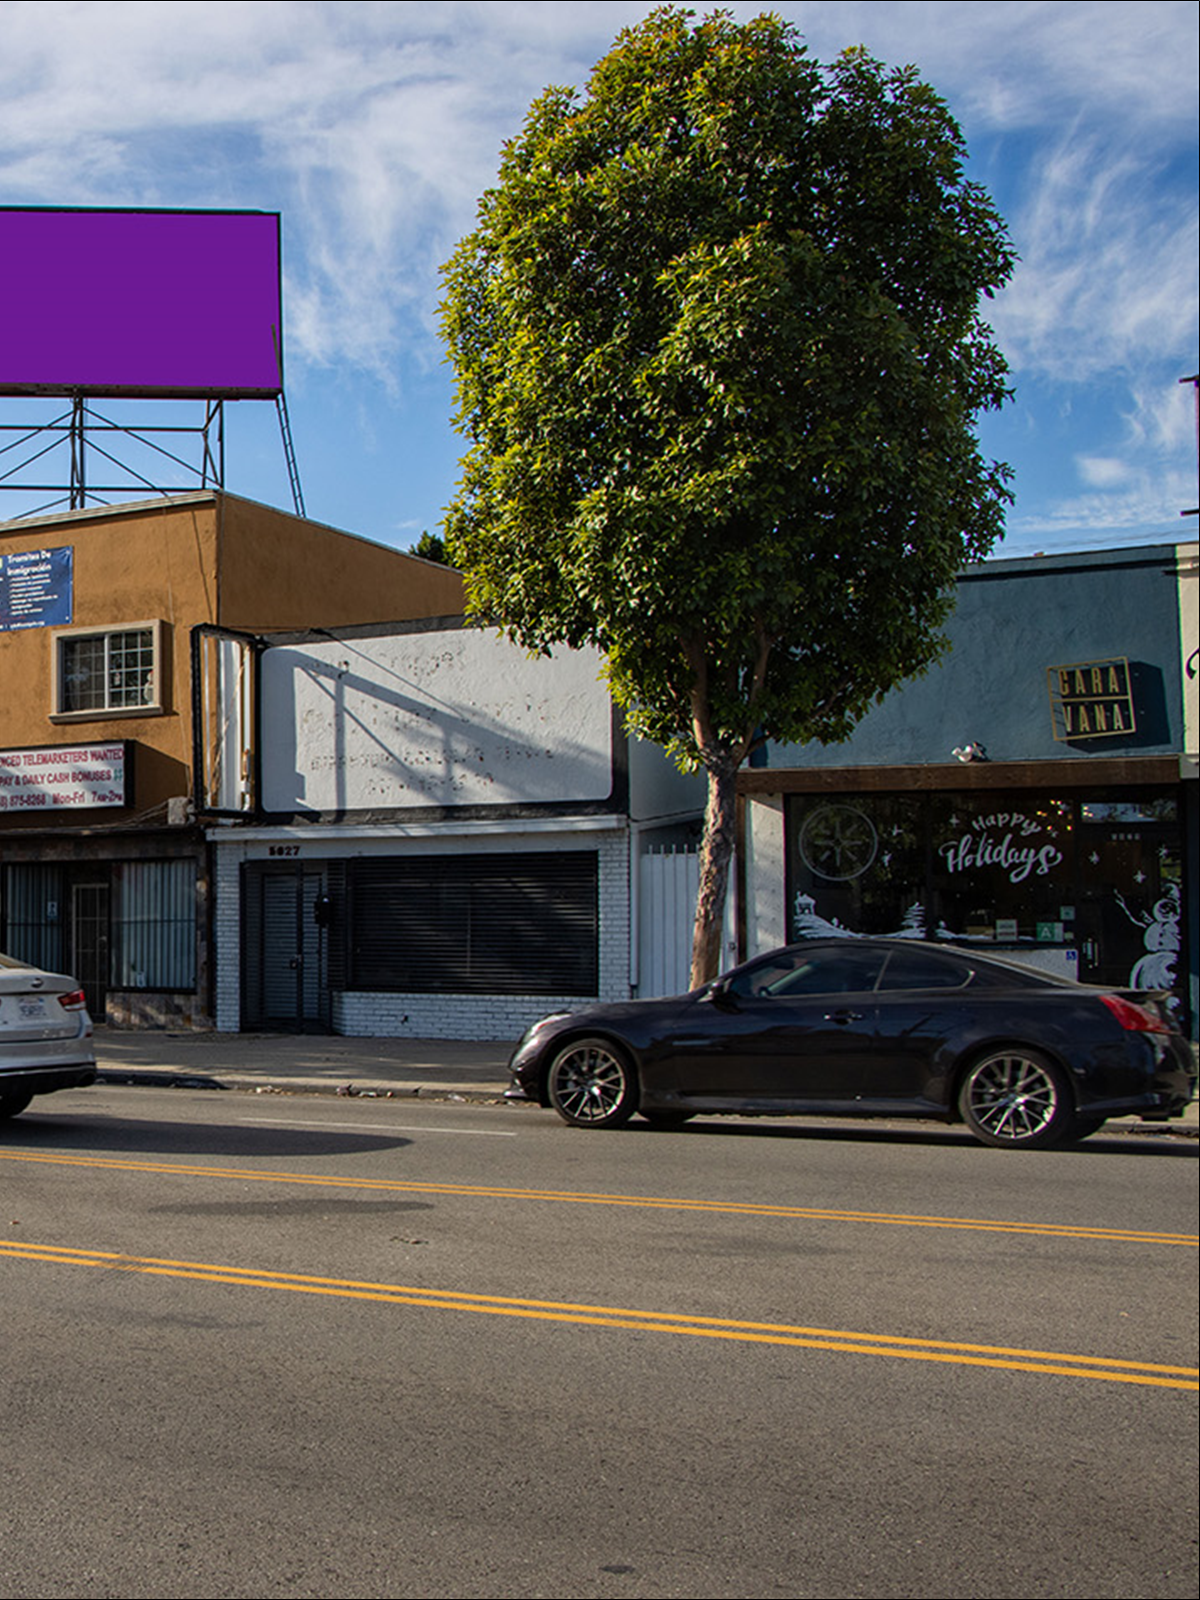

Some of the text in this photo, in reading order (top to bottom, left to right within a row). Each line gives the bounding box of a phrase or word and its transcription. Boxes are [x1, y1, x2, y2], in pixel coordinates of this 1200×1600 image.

[1059, 666, 1119, 696] CARA
[1063, 703, 1124, 732] VANA
[22, 751, 88, 767] TELEMARKETERS
[90, 748, 125, 762] WANTED
[22, 773, 46, 785] DAILY
[46, 772, 70, 784] CASH
[71, 769, 112, 782] BONUSES
[971, 812, 1042, 836] Happy
[938, 832, 1063, 883] Holidays
[1040, 926, 1052, 939] A
